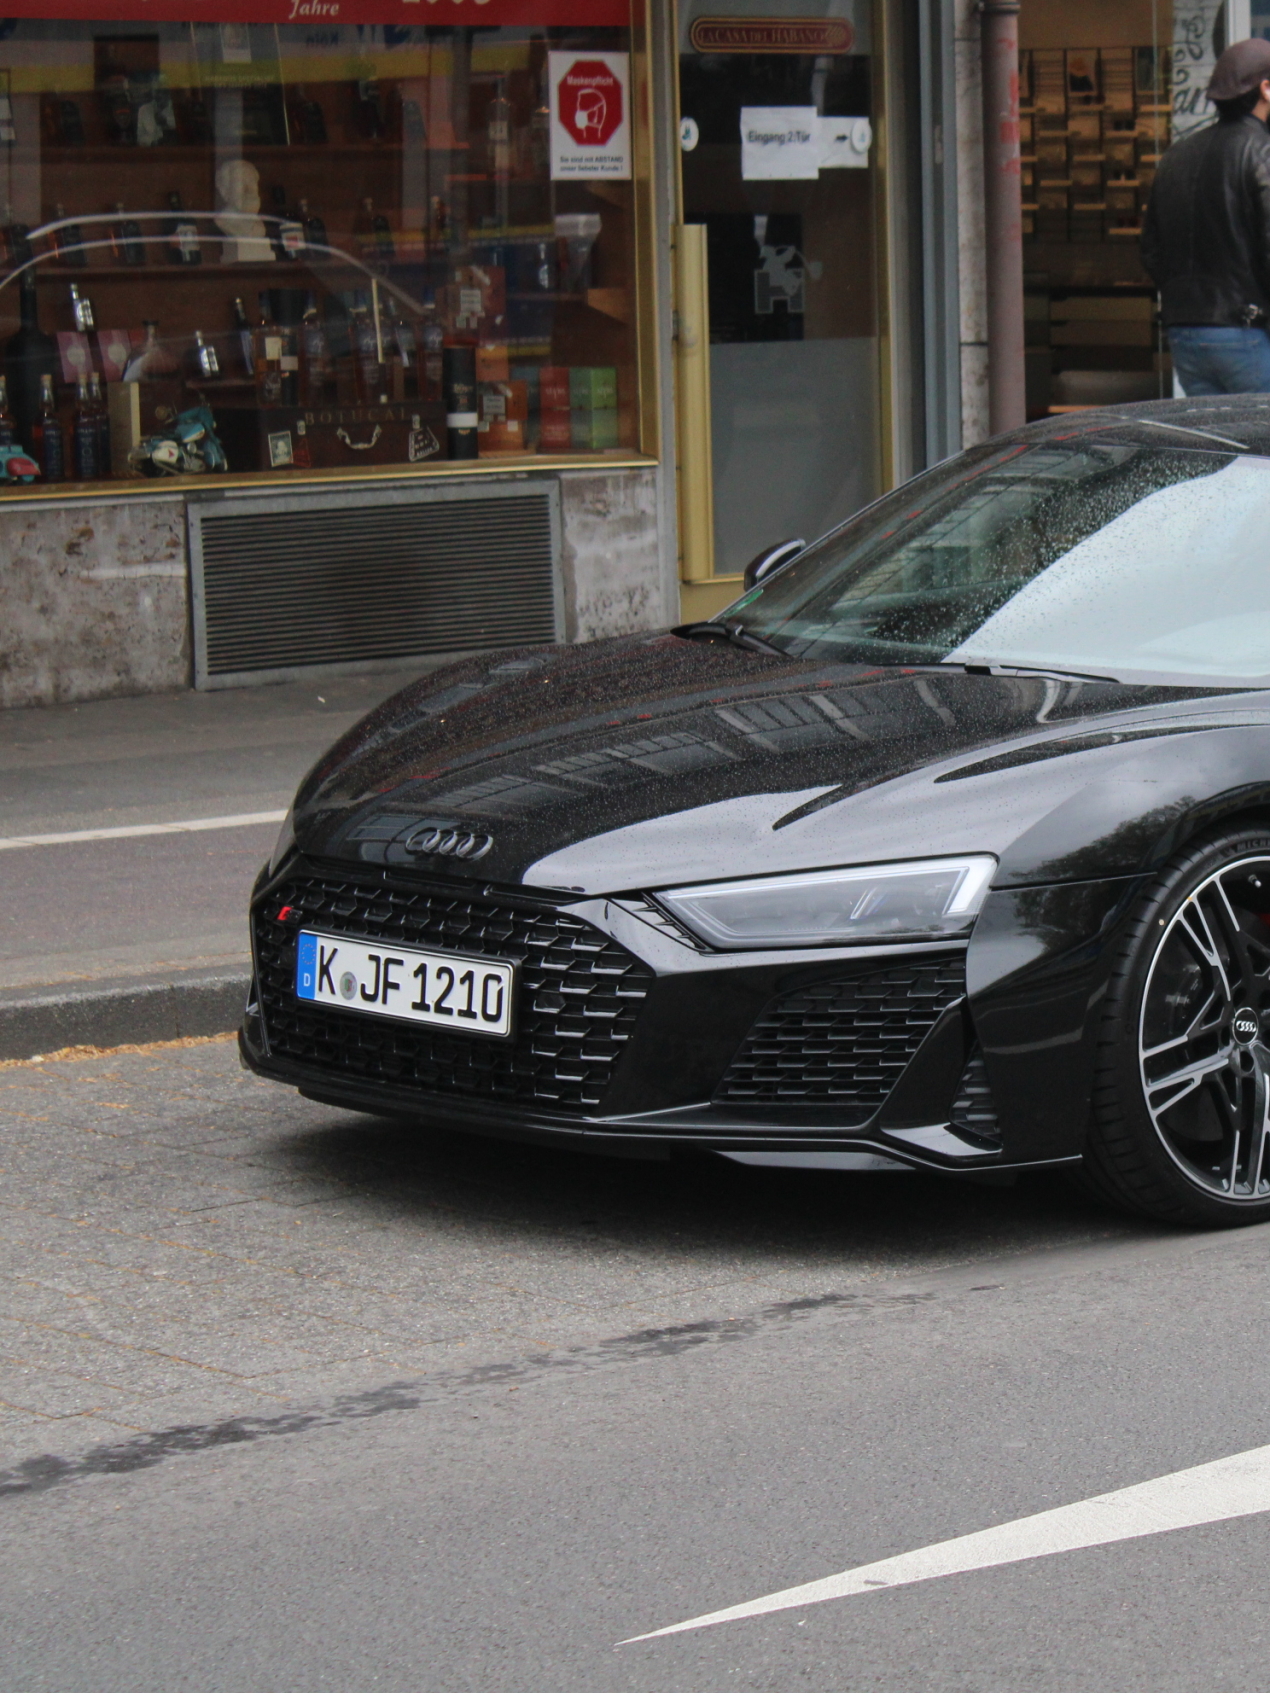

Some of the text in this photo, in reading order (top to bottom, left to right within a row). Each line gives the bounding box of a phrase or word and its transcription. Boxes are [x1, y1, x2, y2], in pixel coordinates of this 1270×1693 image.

[288, 0, 340, 20] Jahre
[715, 29, 747, 43] CASA
[566, 75, 614, 87] Maskenpflicht
[748, 131, 786, 146] Eingang
[303, 973, 312, 987] D
[318, 945, 504, 1023] K JF 1210
